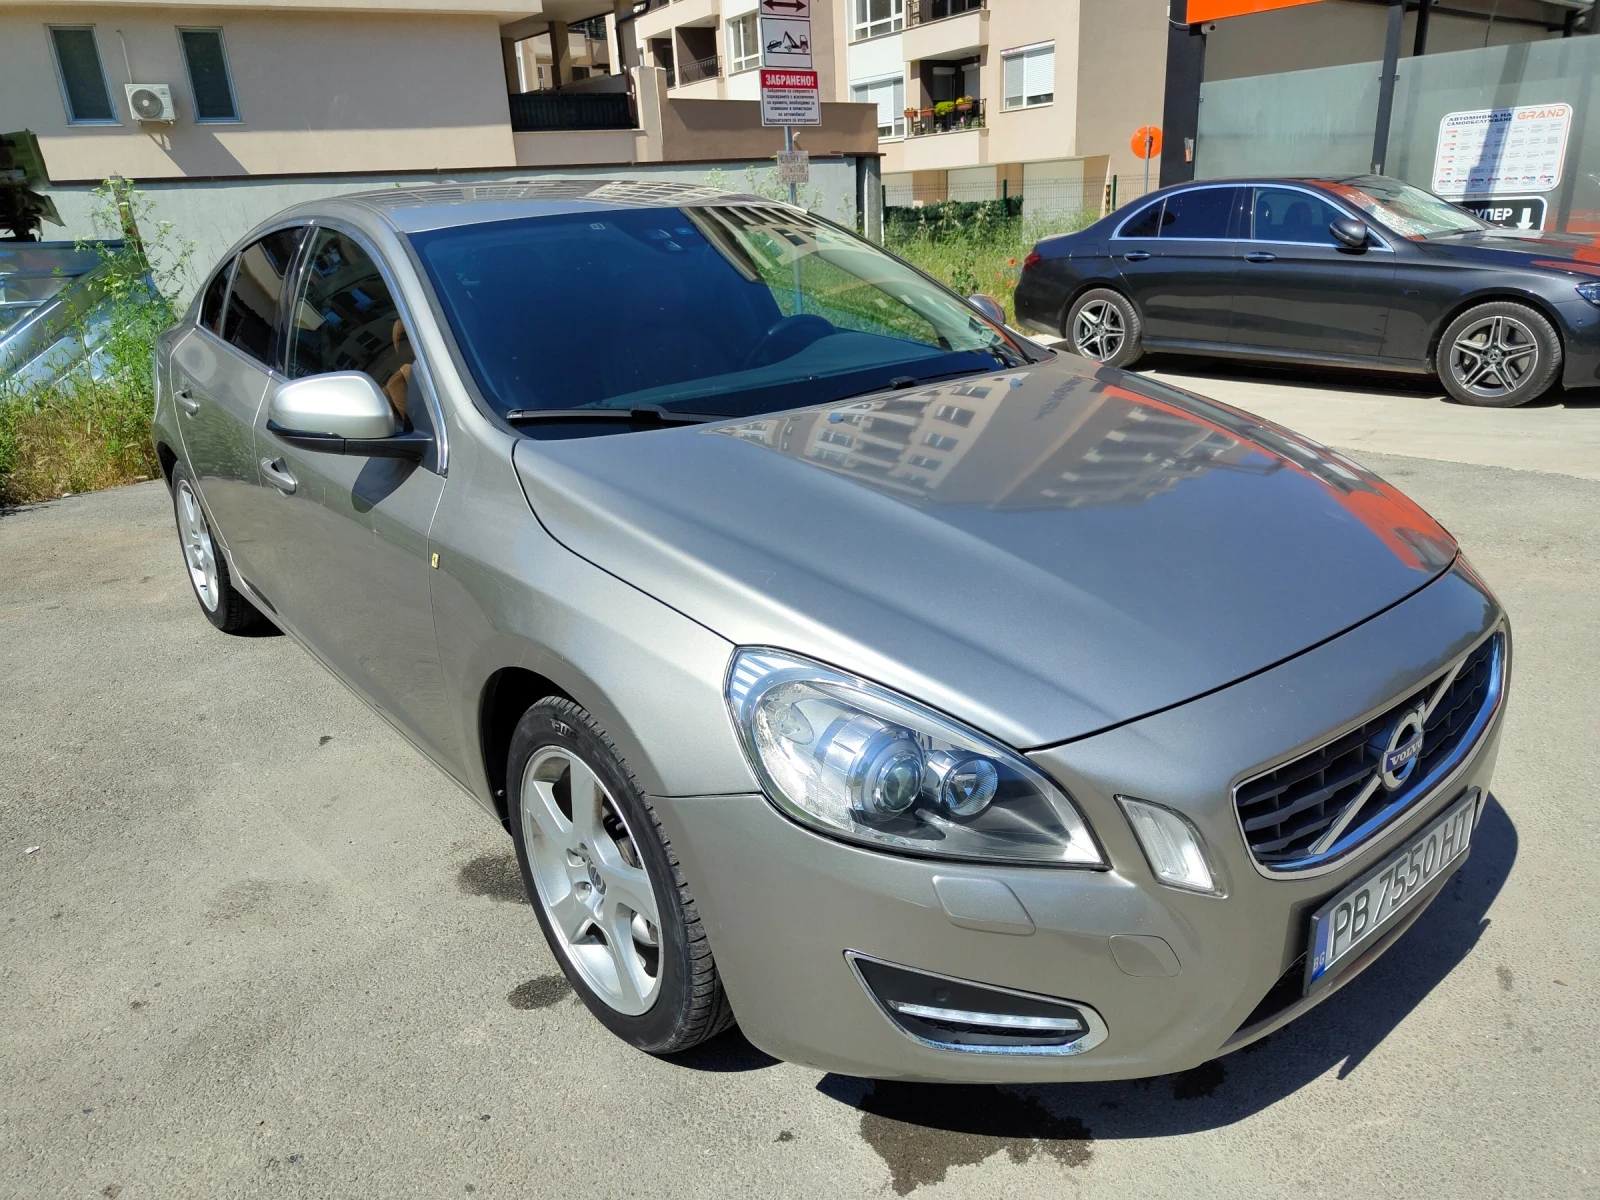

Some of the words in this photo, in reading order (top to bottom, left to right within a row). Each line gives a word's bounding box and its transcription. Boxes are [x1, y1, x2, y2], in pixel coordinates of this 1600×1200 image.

[765, 74, 815, 86] ЗАБРАНЕНО!
[1448, 114, 1498, 122] АВТОМИВКА
[1517, 109, 1566, 120] GRAND
[1446, 117, 1513, 127] САМООБСЛУЖВАНЕ
[1389, 738, 1423, 766] VOLVO
[1313, 951, 1326, 972] BG
